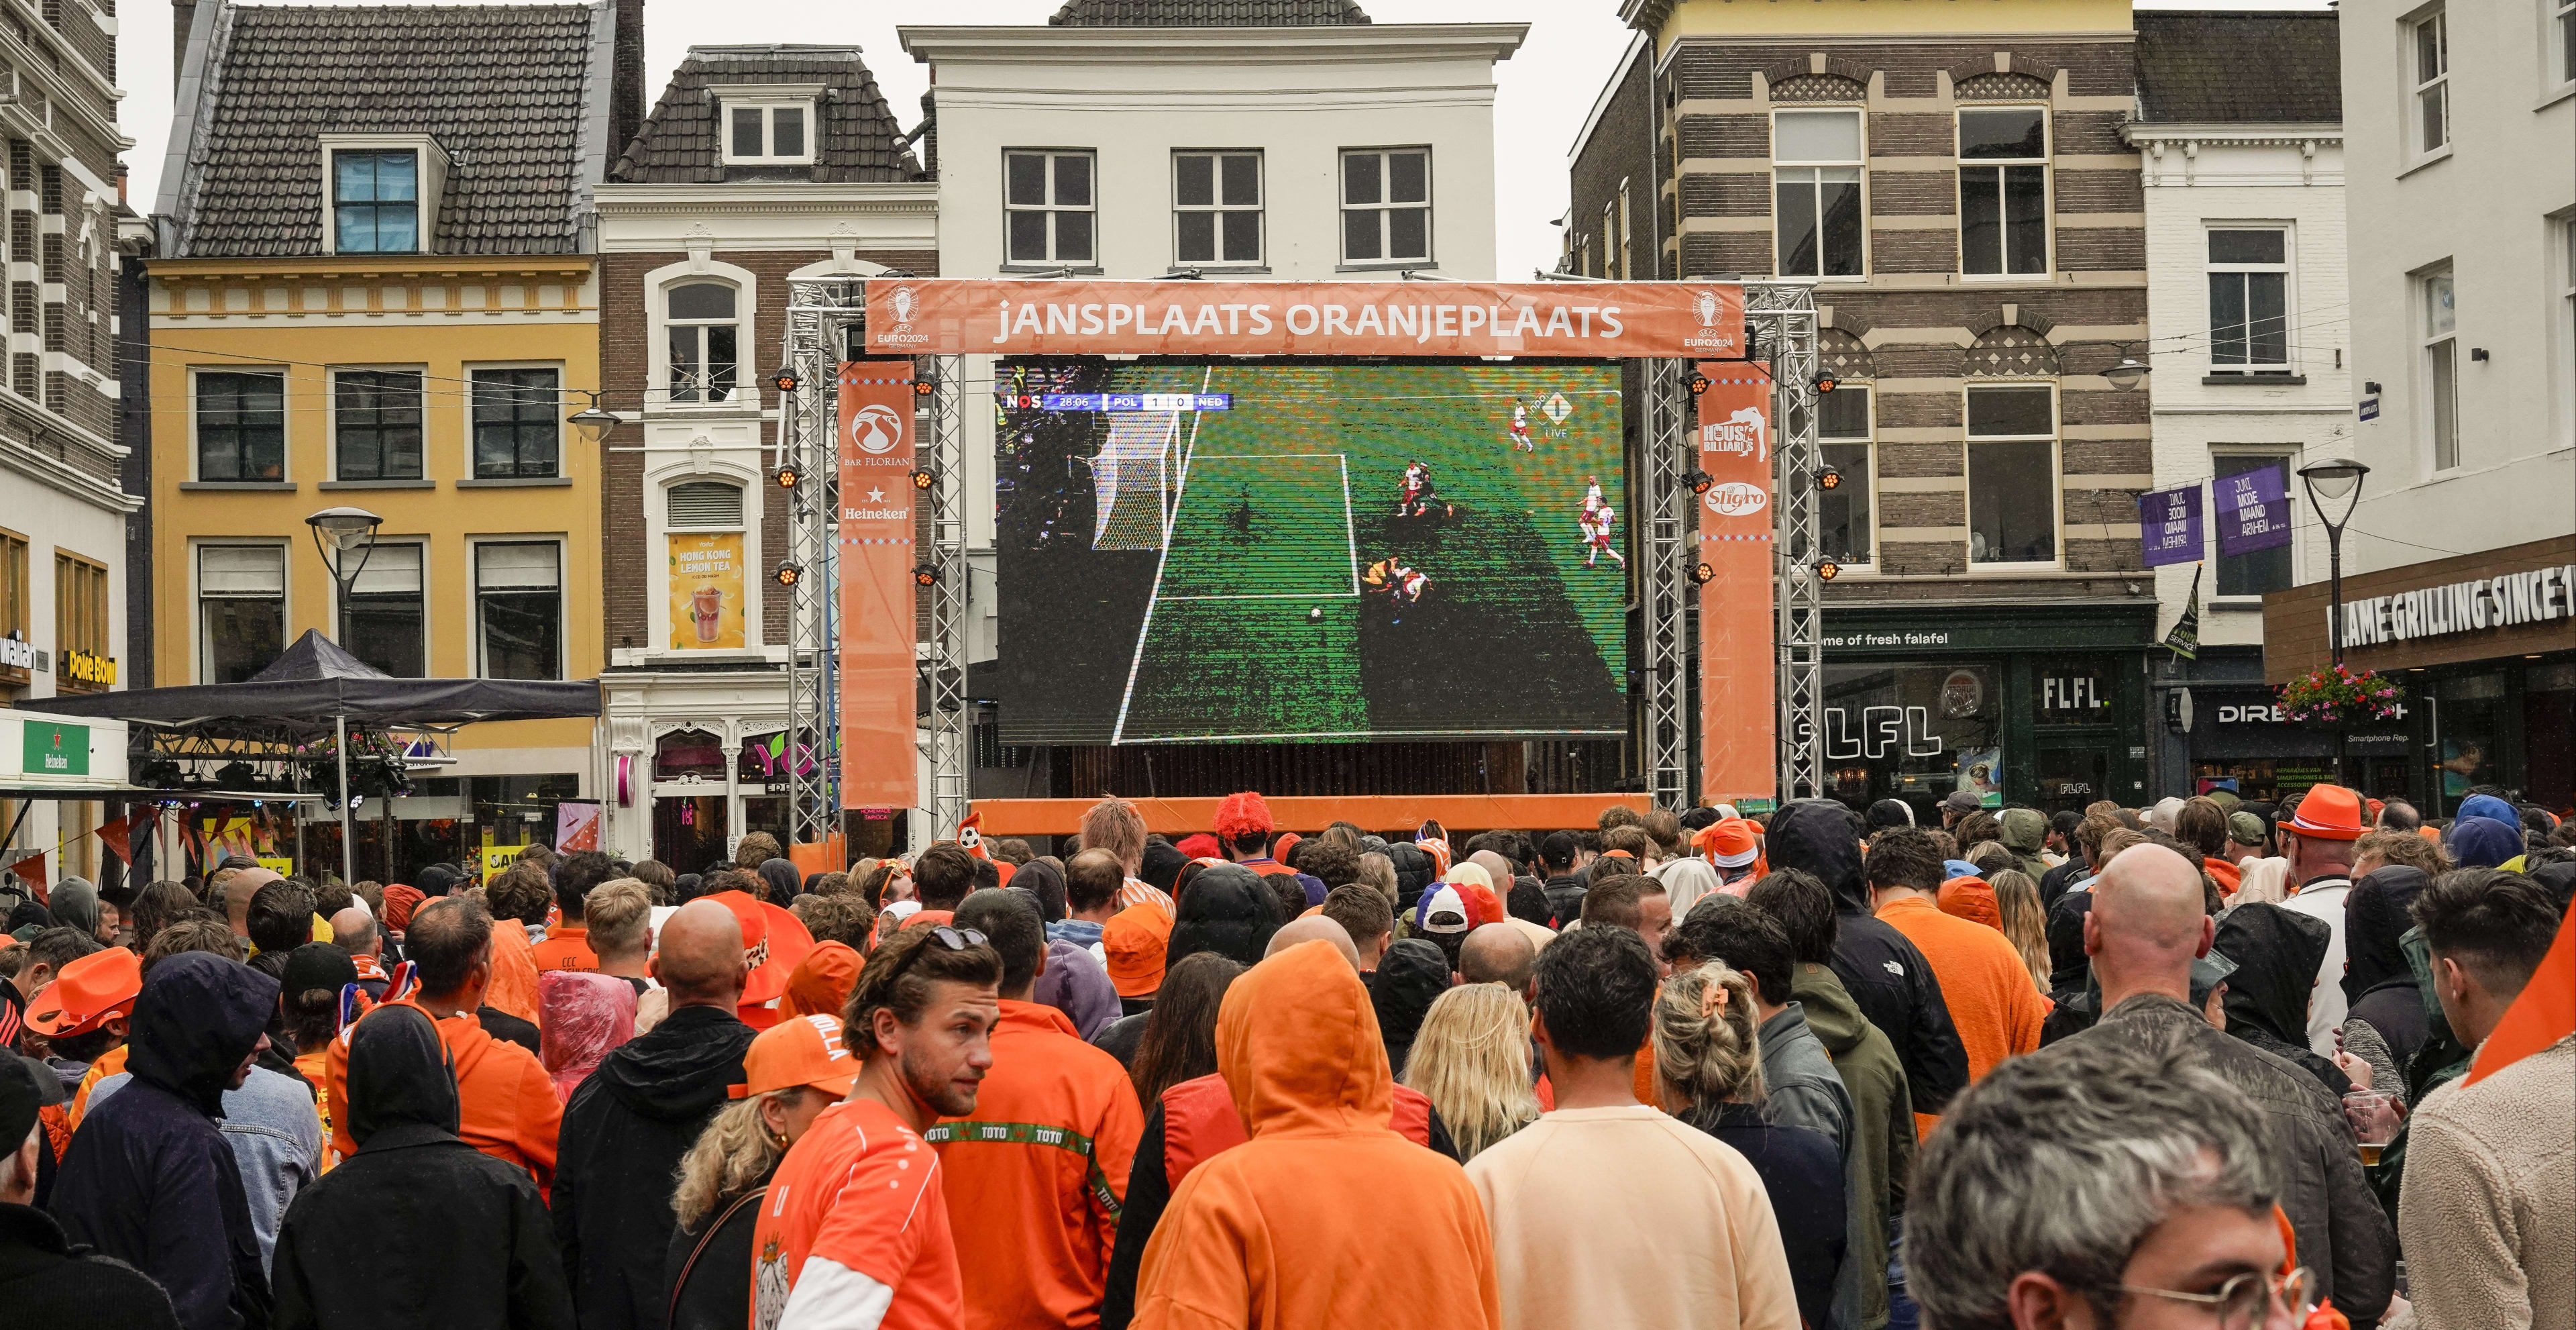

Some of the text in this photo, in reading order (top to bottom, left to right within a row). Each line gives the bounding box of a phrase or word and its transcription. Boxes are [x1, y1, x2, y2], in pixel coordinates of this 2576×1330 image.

[1285, 304, 1623, 344] ORANJEPLAATS
[1006, 395, 1223, 408] NOS 28:06 POL 1 0 NED
[1529, 395, 1546, 413] npo
[1545, 429, 1567, 438] LIVE
[1703, 425, 1753, 441] HOUSE
[1703, 441, 1754, 452] BILLIARDS
[865, 458, 910, 466] FLORIAN
[2235, 477, 2252, 493] JUNI
[1708, 490, 1764, 508] Sligro
[2237, 491, 2259, 507] MODE
[2239, 504, 2265, 521] MAAND
[2242, 519, 2269, 537] ARNHEM
[680, 549, 731, 562] HONG KONG
[680, 561, 730, 574] LEMON TEA
[2392, 579, 2487, 640] GRILLING
[2491, 567, 2559, 627] SINCE
[1847, 634, 1862, 646] of
[1865, 633, 1901, 646] fresh
[1904, 632, 1948, 645] falafel
[2169, 634, 2195, 651] SERVICE
[2043, 677, 2101, 709] FLFL
[2348, 734, 2391, 743] Smartphone
[45, 753, 67, 769] Heineken
[2060, 782, 2091, 795] FLFL
[562, 957, 577, 968] CCC
[981, 1126, 1007, 1139] TOTO
[1036, 1129, 1063, 1144] TOTO
